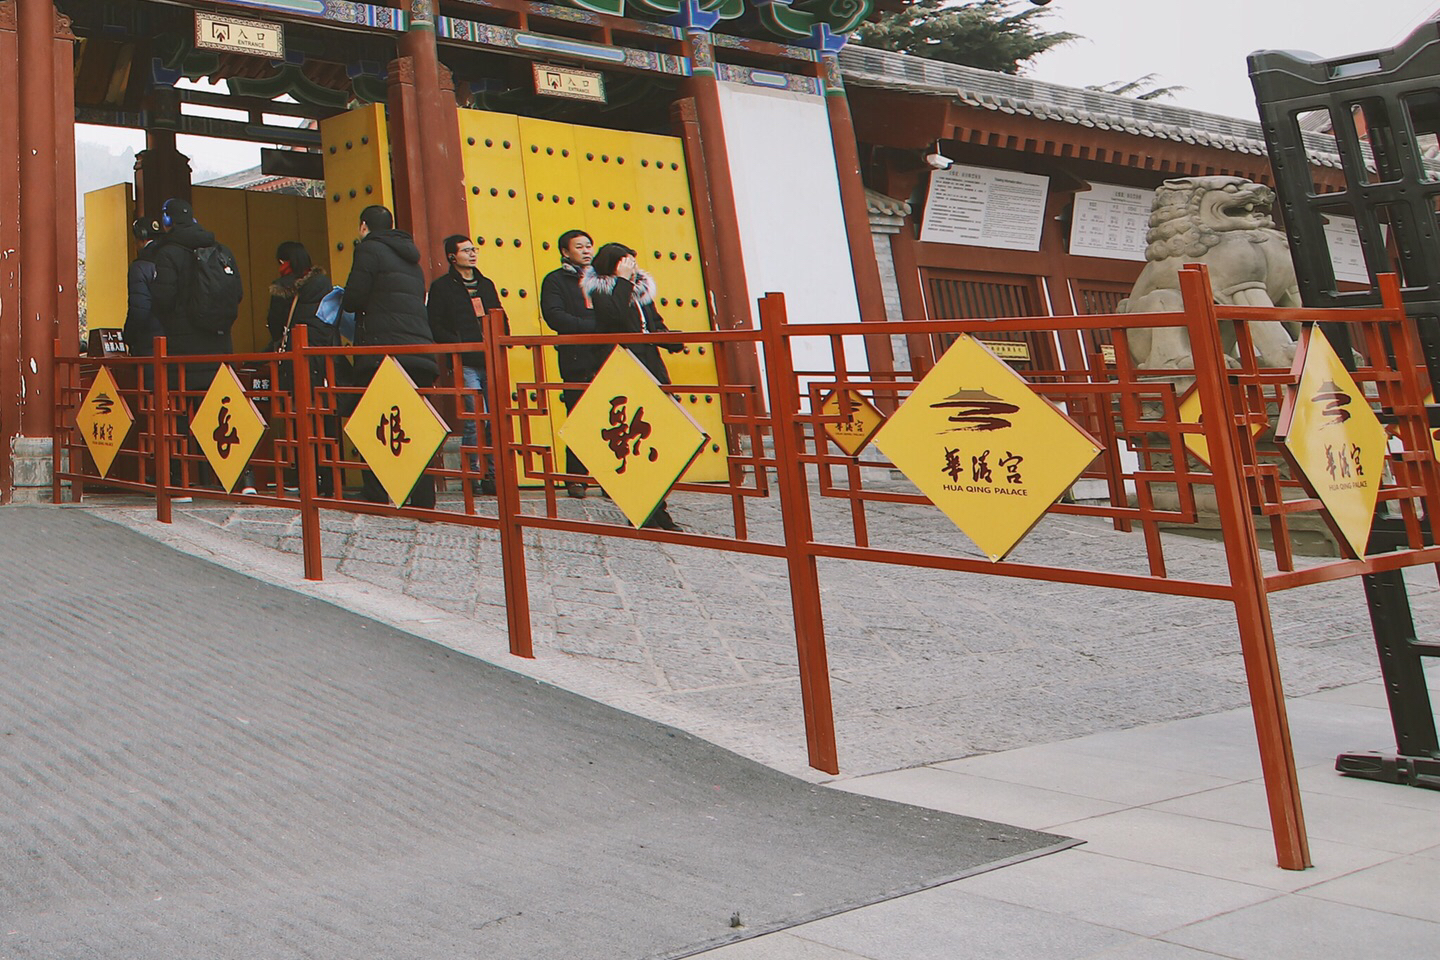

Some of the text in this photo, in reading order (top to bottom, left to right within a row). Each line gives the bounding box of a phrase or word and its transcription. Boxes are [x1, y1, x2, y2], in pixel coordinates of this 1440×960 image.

[237, 28, 265, 41] 入口
[237, 39, 265, 49] ENTRANCE
[567, 77, 590, 88] 入口
[567, 86, 590, 94] ENTRANCE
[375, 405, 411, 457] 恨
[601, 396, 659, 475] 歌
[942, 484, 1028, 497] HUA QING PALACE
[1339, 482, 1352, 490] QING
[1352, 480, 1368, 488] PALACE
